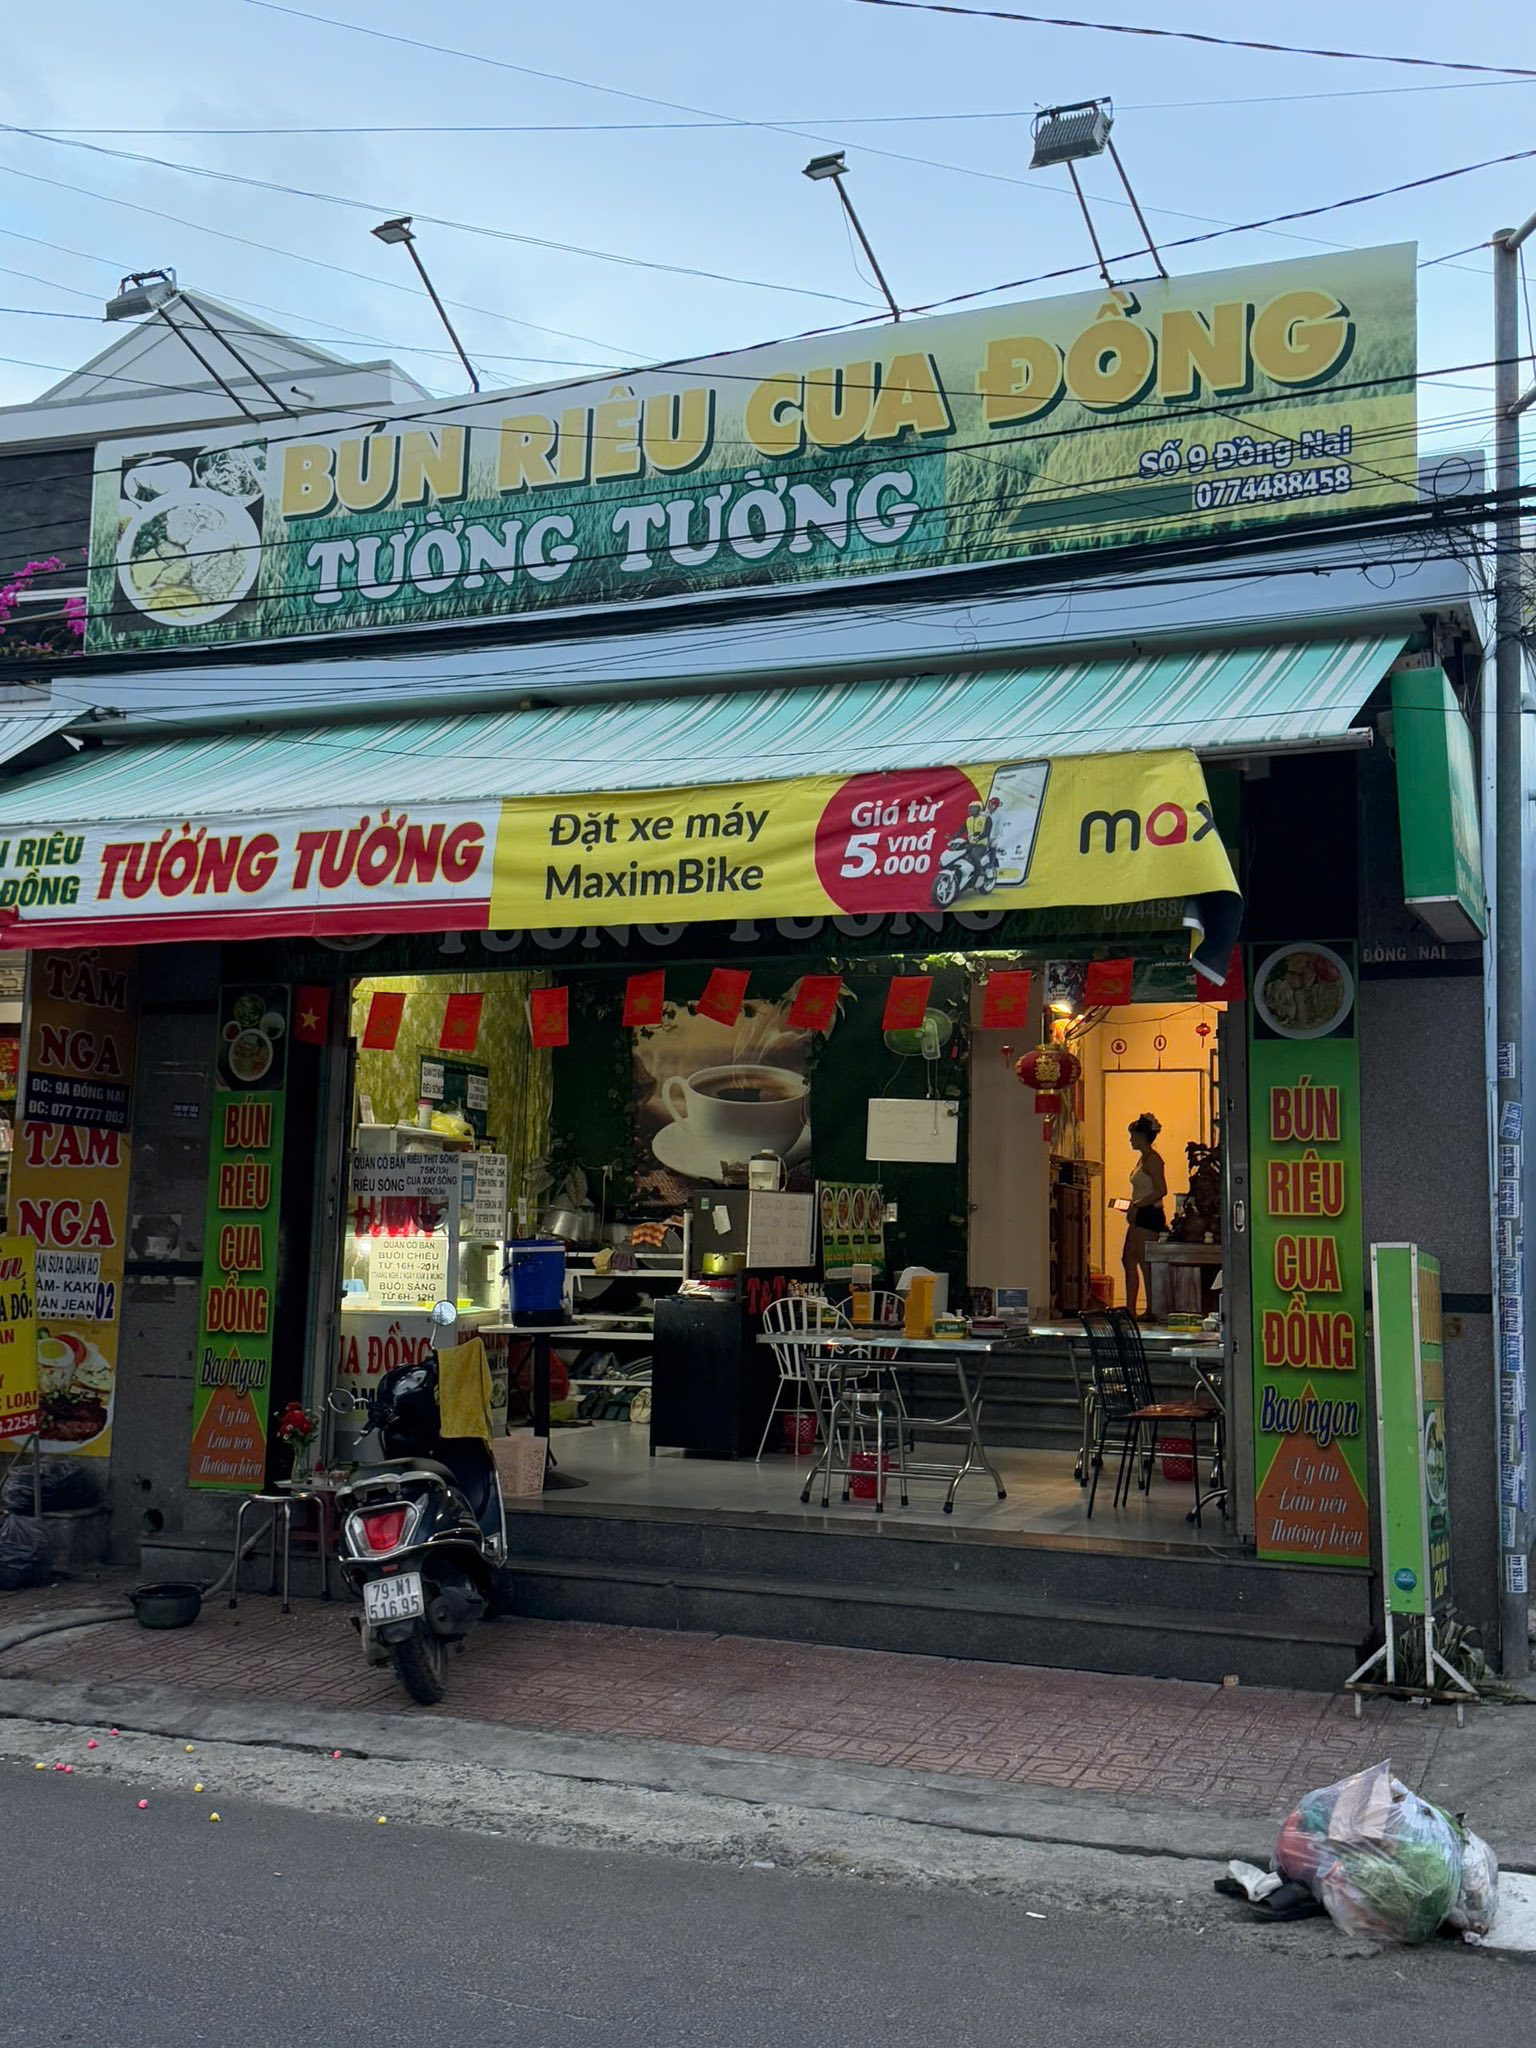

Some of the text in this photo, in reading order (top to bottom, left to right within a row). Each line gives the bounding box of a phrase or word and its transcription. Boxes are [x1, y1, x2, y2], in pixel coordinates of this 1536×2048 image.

[282, 284, 1355, 521] BÚN RIÊU CUA ĐỒNG
[1140, 426, 1352, 477] Số 9 Đồng Nai
[1194, 465, 1352, 510] 0774488458
[307, 470, 921, 604] TƯỜNG TƯỜNG
[549, 801, 771, 852] Đặt xe máy
[851, 796, 944, 828] Giá từ
[14, 831, 86, 867] RIÊU
[97, 809, 485, 900] TƯỜNG TƯỜNG
[887, 828, 937, 853] vnđ
[545, 856, 764, 900] MaximBike
[1419, 945, 1447, 961] NAI
[46, 949, 128, 1012] TẤM
[41, 1024, 122, 1077] NGA
[55, 1081, 70, 1096] 9A
[106, 1089, 126, 1104] NAI
[1270, 1074, 1341, 1142] BÚN
[224, 1093, 272, 1148] BÚN
[219, 1154, 271, 1210] RIÊU
[1268, 1148, 1345, 1217] RIÊU
[18, 1199, 116, 1247] NGA
[220, 1224, 264, 1271] CUA
[64, 1281, 96, 1293] KAKI
[1274, 1235, 1343, 1292] CUA
[206, 1271, 269, 1333] ĐỒNG
[1262, 1291, 1357, 1370] ĐỒNG
[1261, 1384, 1360, 1447] Bao ngon
